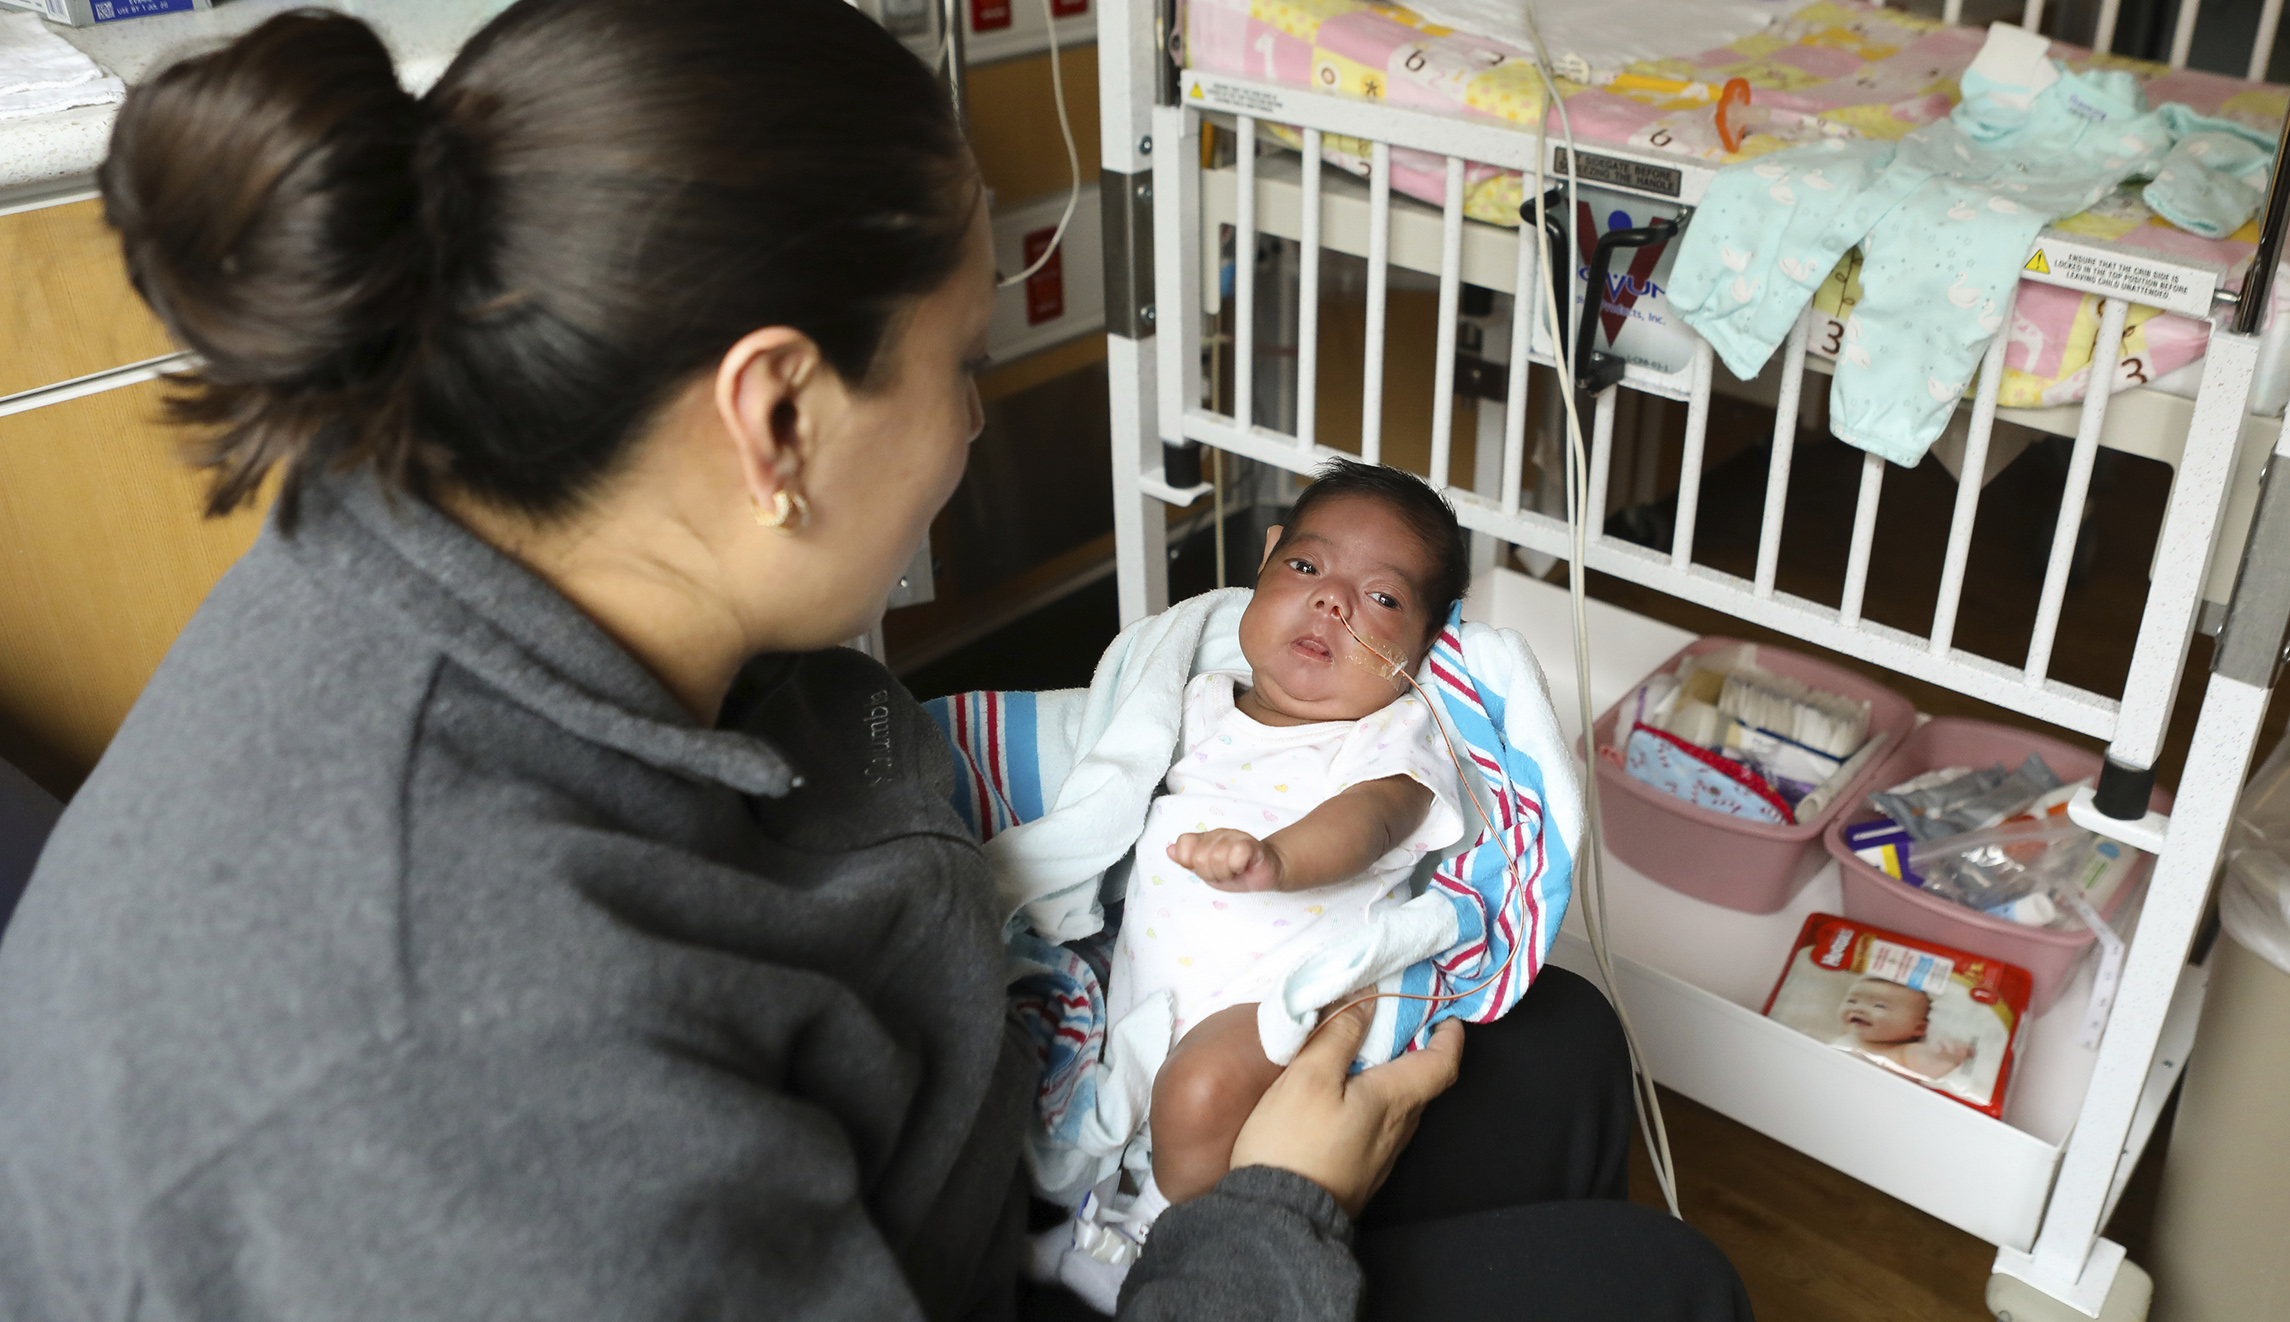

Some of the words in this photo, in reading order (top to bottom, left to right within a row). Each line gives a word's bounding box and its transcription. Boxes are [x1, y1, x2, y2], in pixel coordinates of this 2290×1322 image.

[1405, 49, 1426, 72] 6
[1635, 166, 1672, 180] BEFORE
[1636, 176, 1674, 191] HANDLE
[2054, 259, 2082, 272] LOCKED
[2083, 265, 2091, 273] IN
[2093, 267, 2106, 276] THE
[2108, 270, 2122, 280] TOP
[2123, 273, 2158, 288] POSITION
[2159, 281, 2188, 294] BEFORE
[2068, 254, 2096, 265] ENSURE
[2099, 259, 2117, 270] THAT
[2119, 264, 2132, 273] THE
[2134, 267, 2151, 278] CRIB
[2153, 270, 2169, 281] SIDE
[2171, 274, 2180, 283] IS
[2066, 271, 2096, 284] LEAVING
[2098, 277, 2120, 289] CHILD
[1648, 312, 1667, 326] Inc.
[1821, 320, 1844, 355] 3
